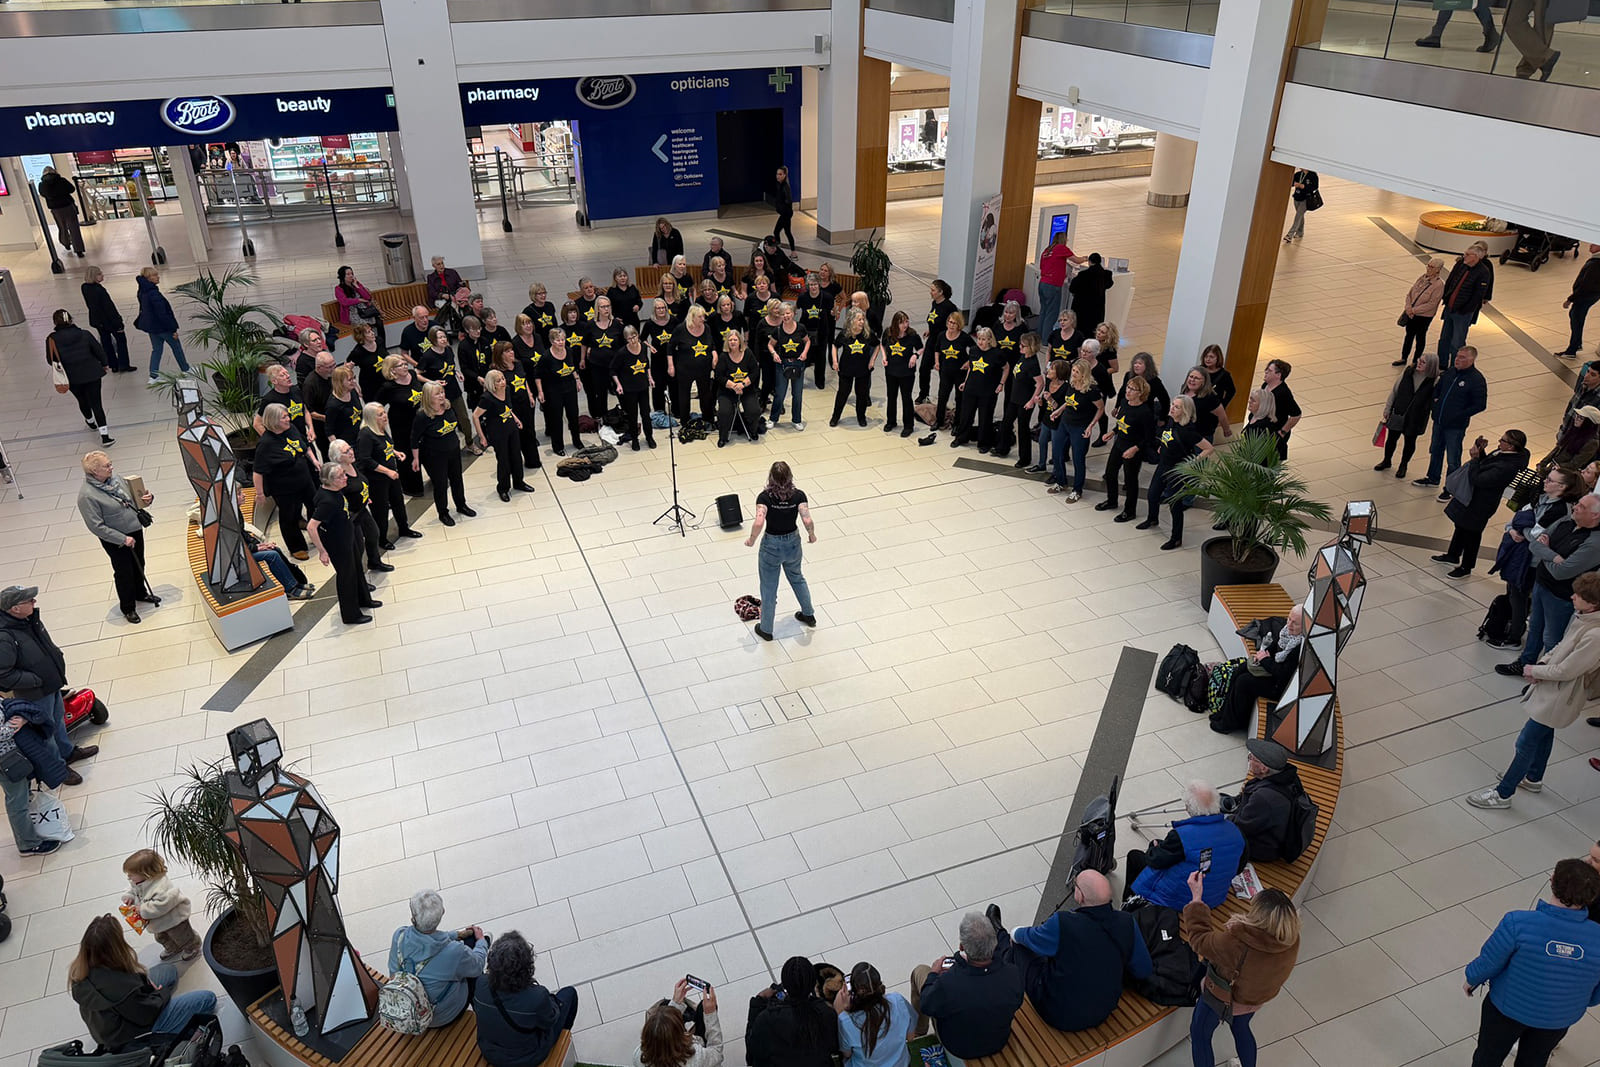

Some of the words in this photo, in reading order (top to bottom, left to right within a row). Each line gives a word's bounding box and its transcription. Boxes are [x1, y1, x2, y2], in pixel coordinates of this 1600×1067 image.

[587, 77, 625, 100] Boots
[670, 76, 730, 91] opticians
[467, 86, 540, 104] pharmacy
[175, 99, 220, 125] Boots
[276, 97, 331, 113] beauty
[24, 109, 115, 130] pharmacy
[30, 807, 60, 824] EXT
